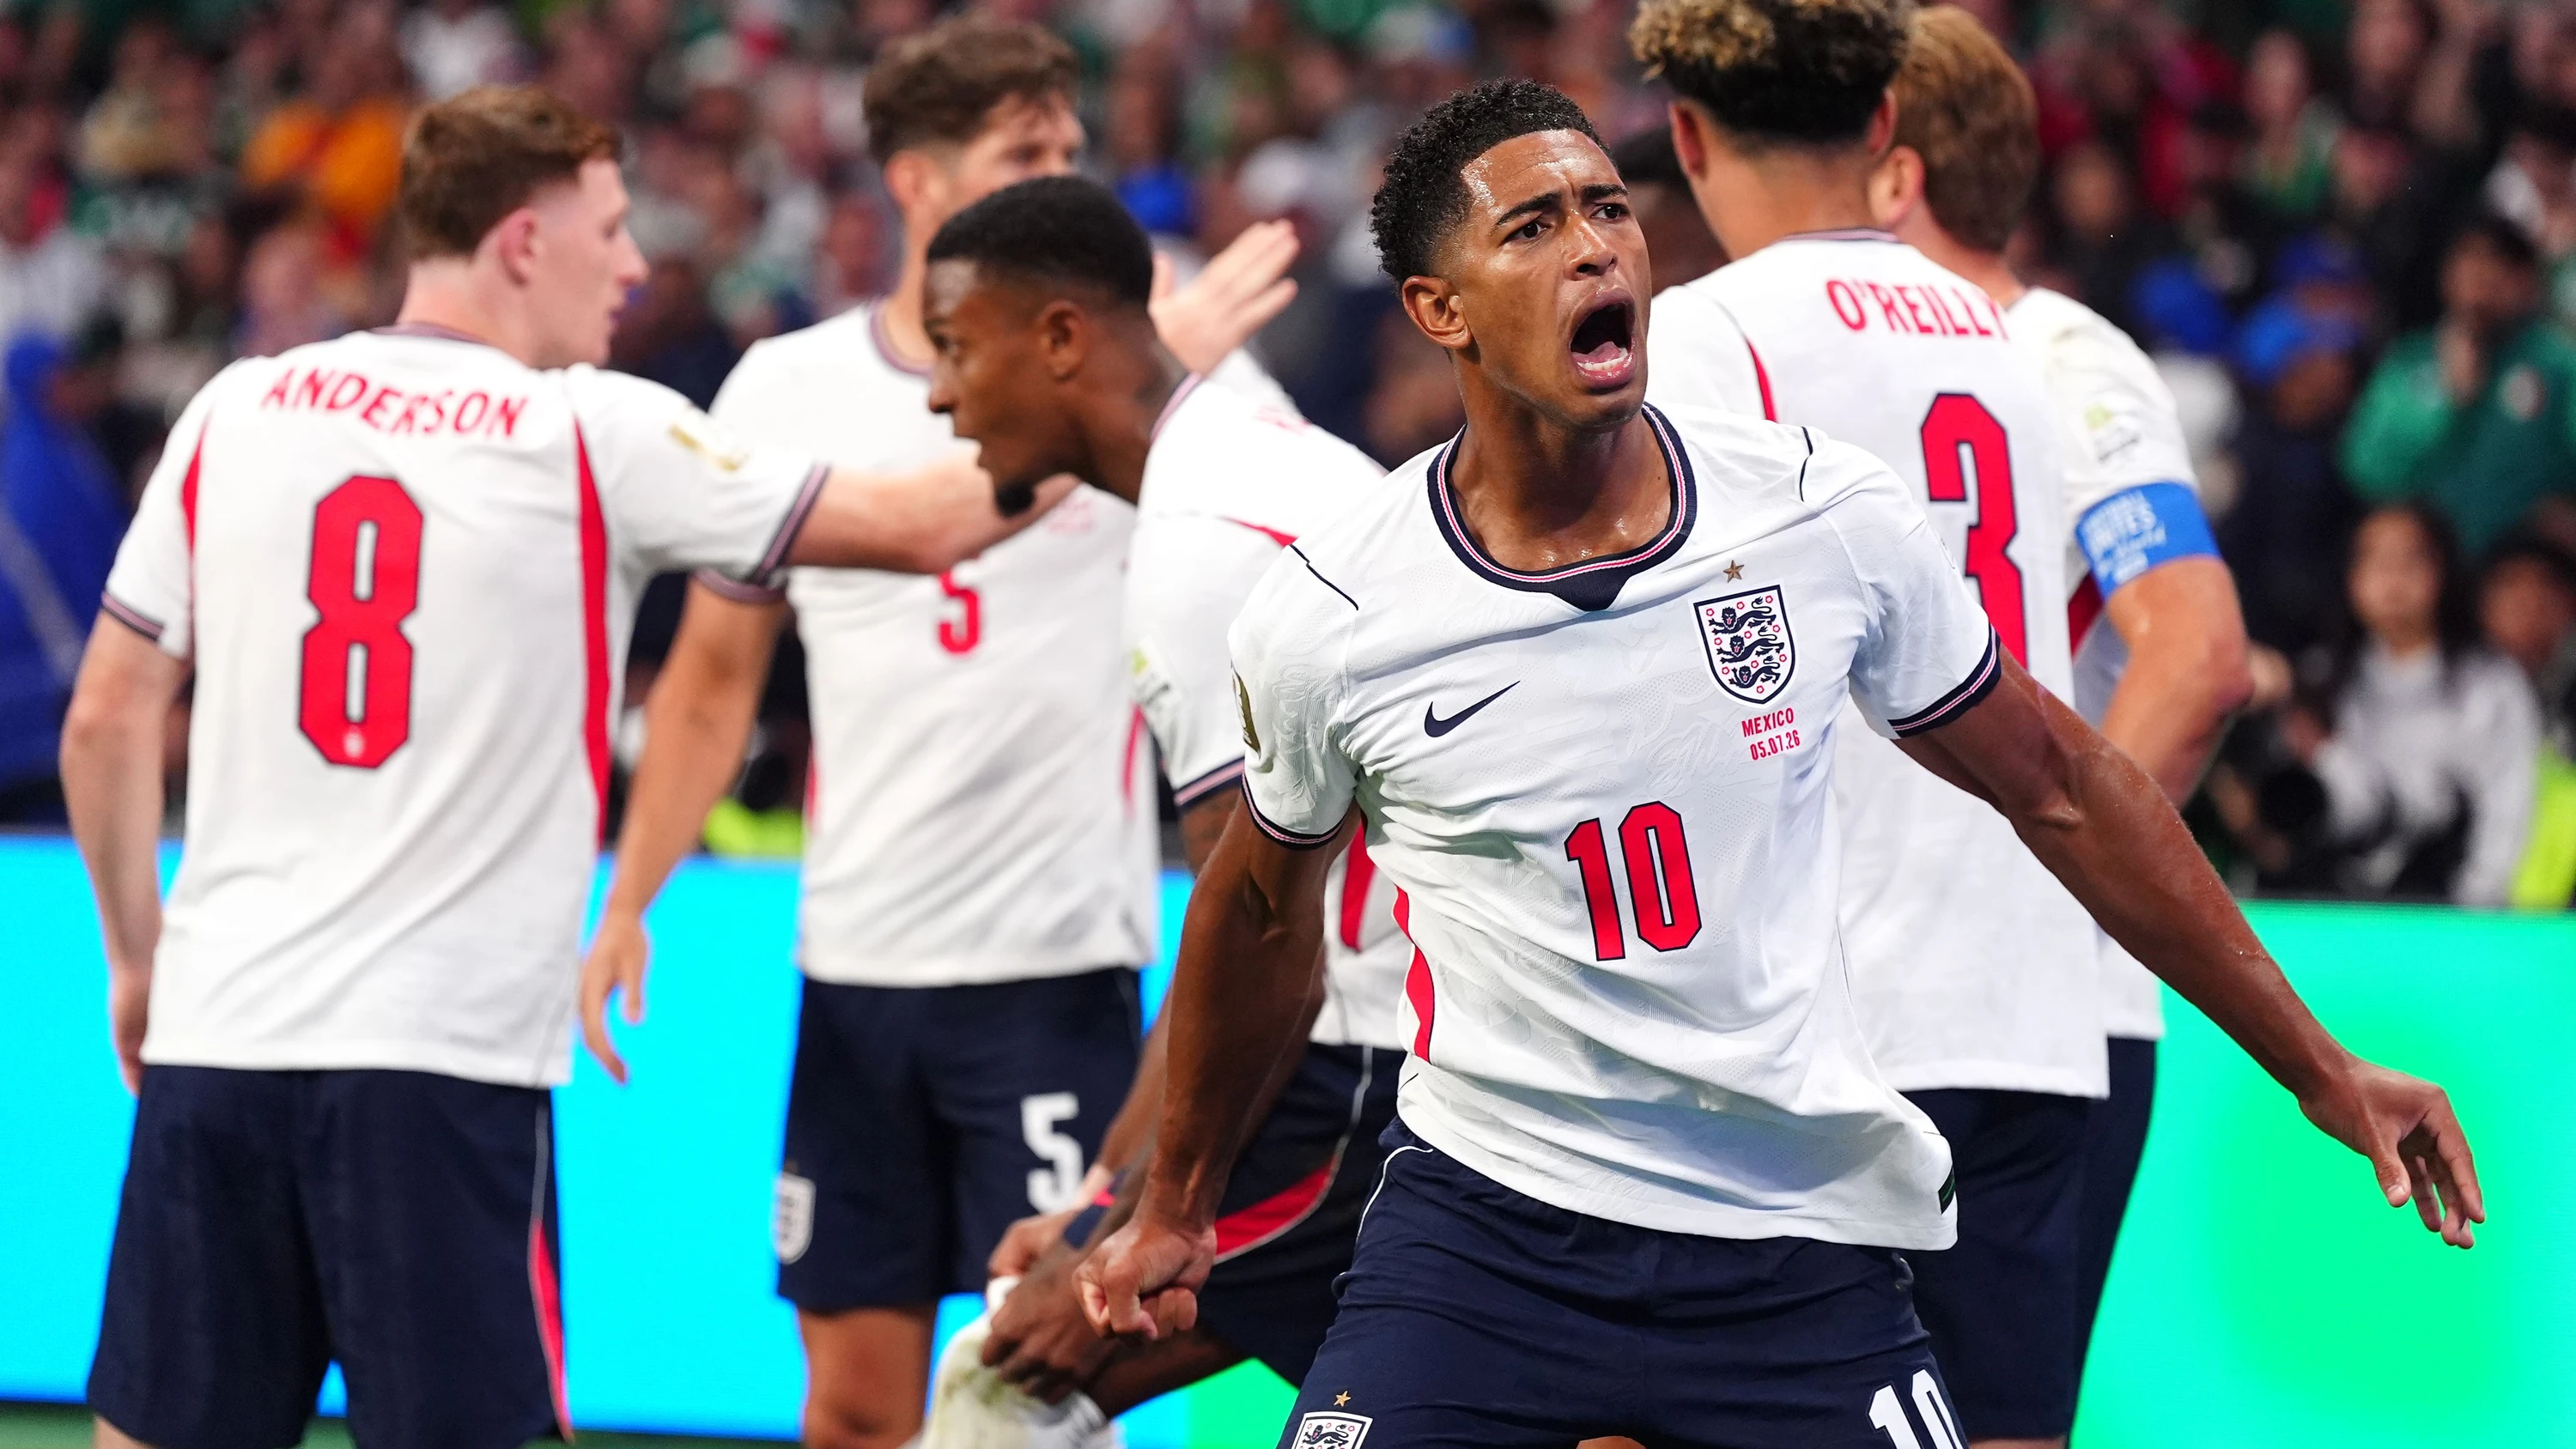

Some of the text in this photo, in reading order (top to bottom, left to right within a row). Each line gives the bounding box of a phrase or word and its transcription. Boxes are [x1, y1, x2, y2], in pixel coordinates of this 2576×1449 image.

[261, 367, 527, 439] ANDERSON
[1920, 391, 2028, 673] 3
[298, 474, 423, 769] 8
[938, 568, 980, 655] 5
[1741, 707, 1794, 737] MEXICO
[1750, 730, 1801, 761] 05.07.26
[1564, 801, 1702, 961] 10
[1020, 1092, 1084, 1216] 5
[1868, 1368, 1964, 1449] 10
